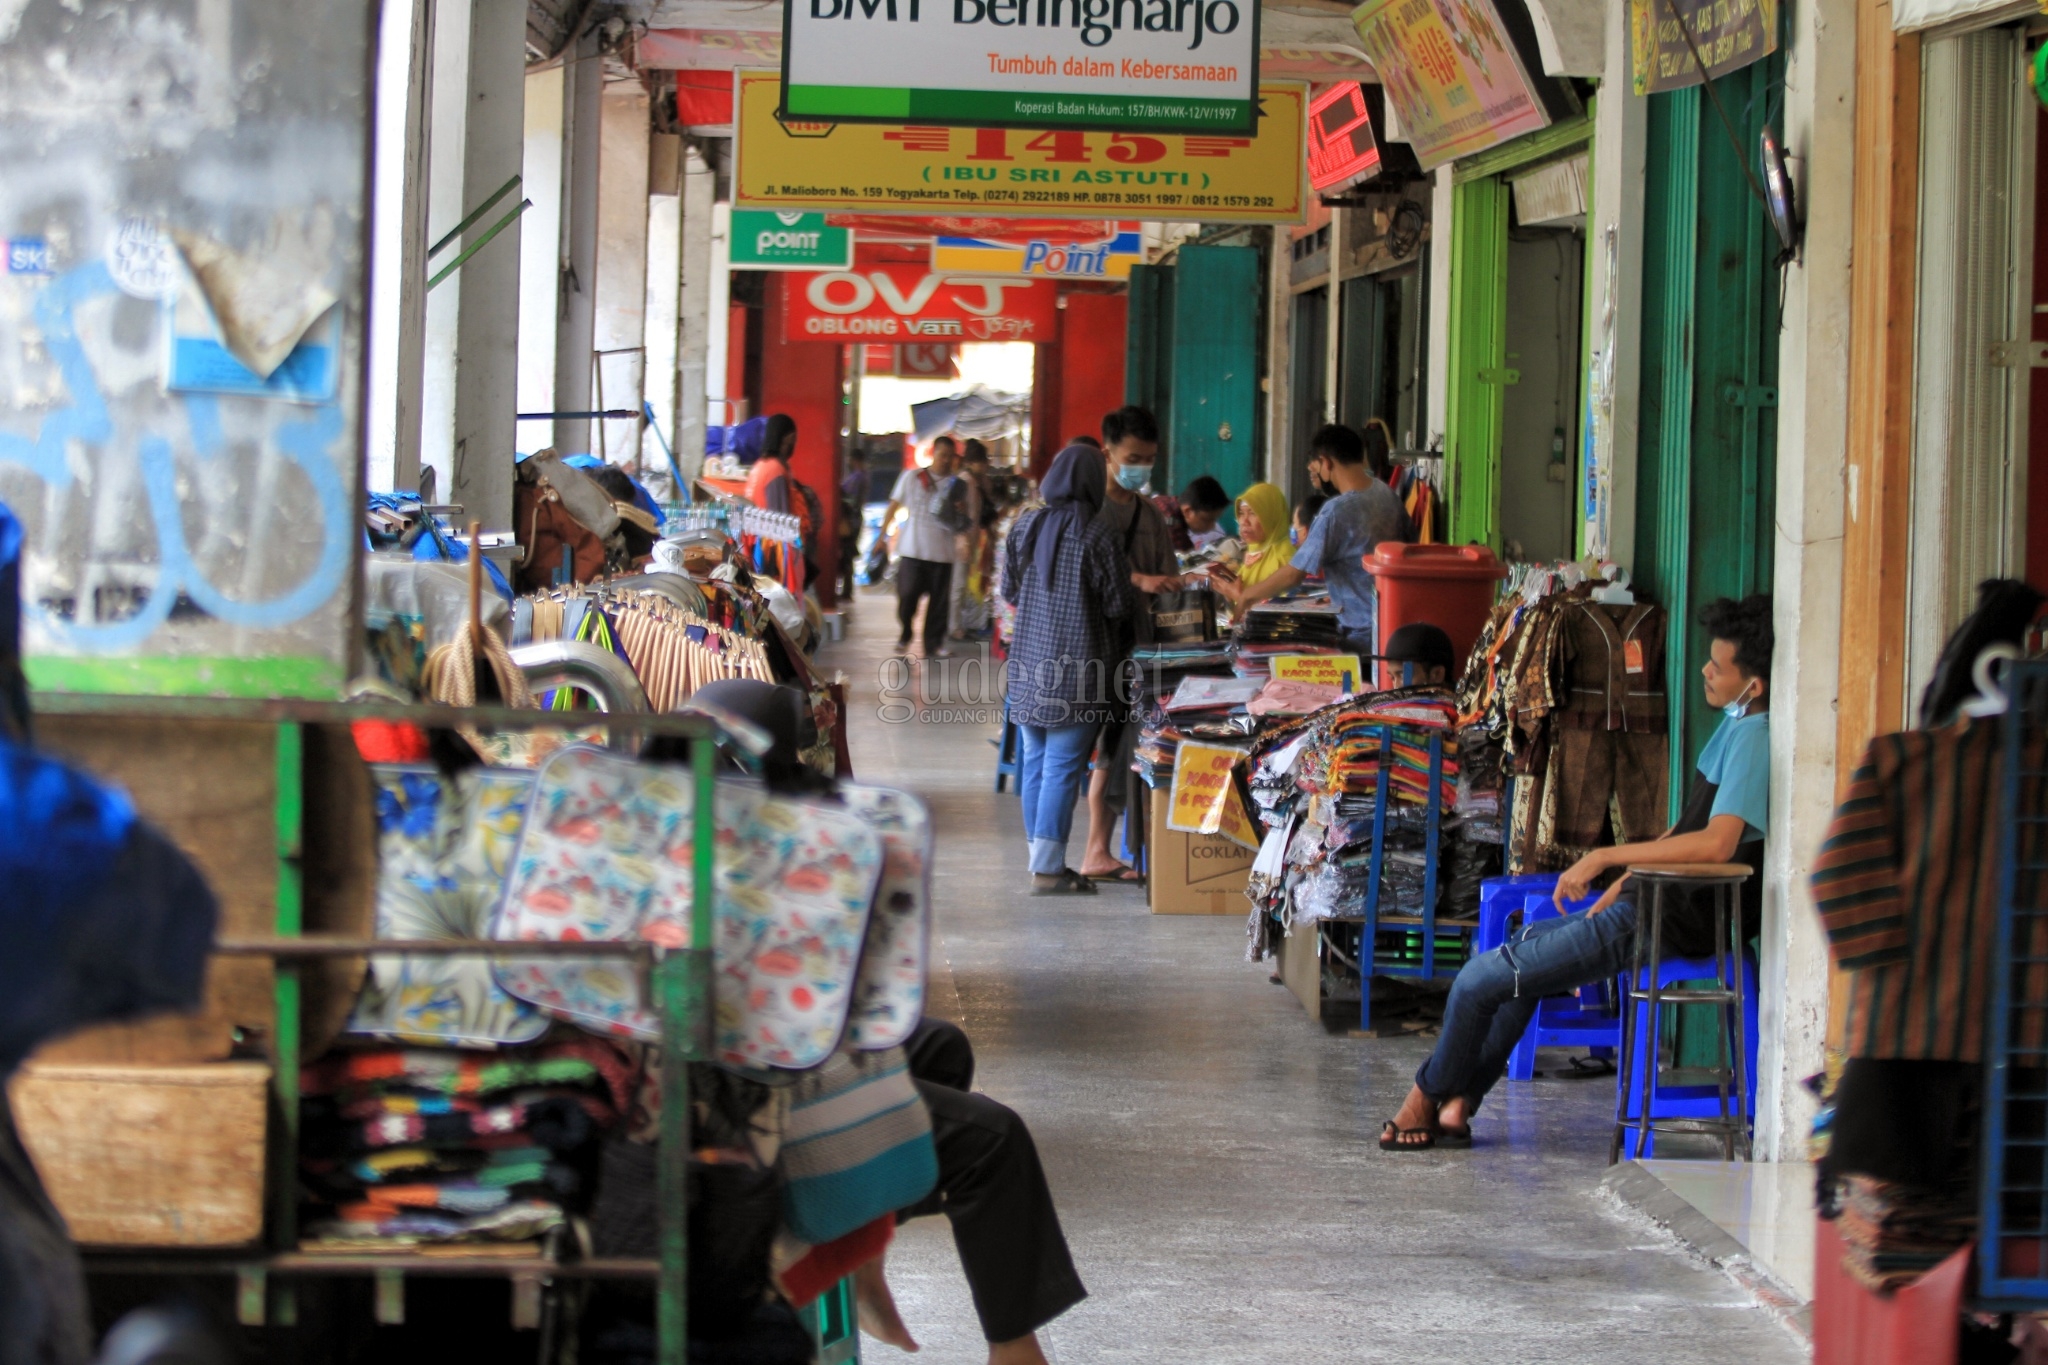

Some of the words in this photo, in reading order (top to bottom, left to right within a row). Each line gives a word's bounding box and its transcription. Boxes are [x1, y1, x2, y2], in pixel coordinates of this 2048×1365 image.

[987, 53, 1057, 76] Tumbuh
[1063, 56, 1115, 78] dalam
[1121, 58, 1238, 82] Kebersamaan
[1015, 100, 1055, 116] Koperasi
[1057, 101, 1085, 115] Badan
[1088, 103, 1124, 117] Hukum:
[1128, 105, 1237, 121] 157/BH/KWK-12/V/1997
[966, 128, 1168, 165] 145
[943, 167, 997, 181] IBU
[1009, 168, 1060, 182] SRI
[1071, 170, 1189, 186] ASTUTI
[764, 185, 778, 196] Jl.
[781, 185, 837, 197] Malioboro
[840, 187, 859, 197] No.
[863, 187, 883, 198] 159
[886, 187, 950, 201] Yogyakarta
[953, 189, 980, 201] Telp.
[984, 190, 1019, 203] (0274)
[1073, 192, 1091, 203] HP.
[1094, 193, 1122, 204] 0878
[1125, 193, 1151, 204] 3051
[1156, 194, 1183, 205] 1997
[1192, 194, 1220, 206] 0812
[1223, 195, 1250, 207] 1579
[1253, 196, 1274, 207] 292
[1023, 239, 1110, 276] Point
[806, 271, 1035, 316] OVJ
[805, 317, 898, 335] OBLONG
[1315, 669, 1352, 678] JOGJ
[1191, 846, 1248, 859] COKLAT
